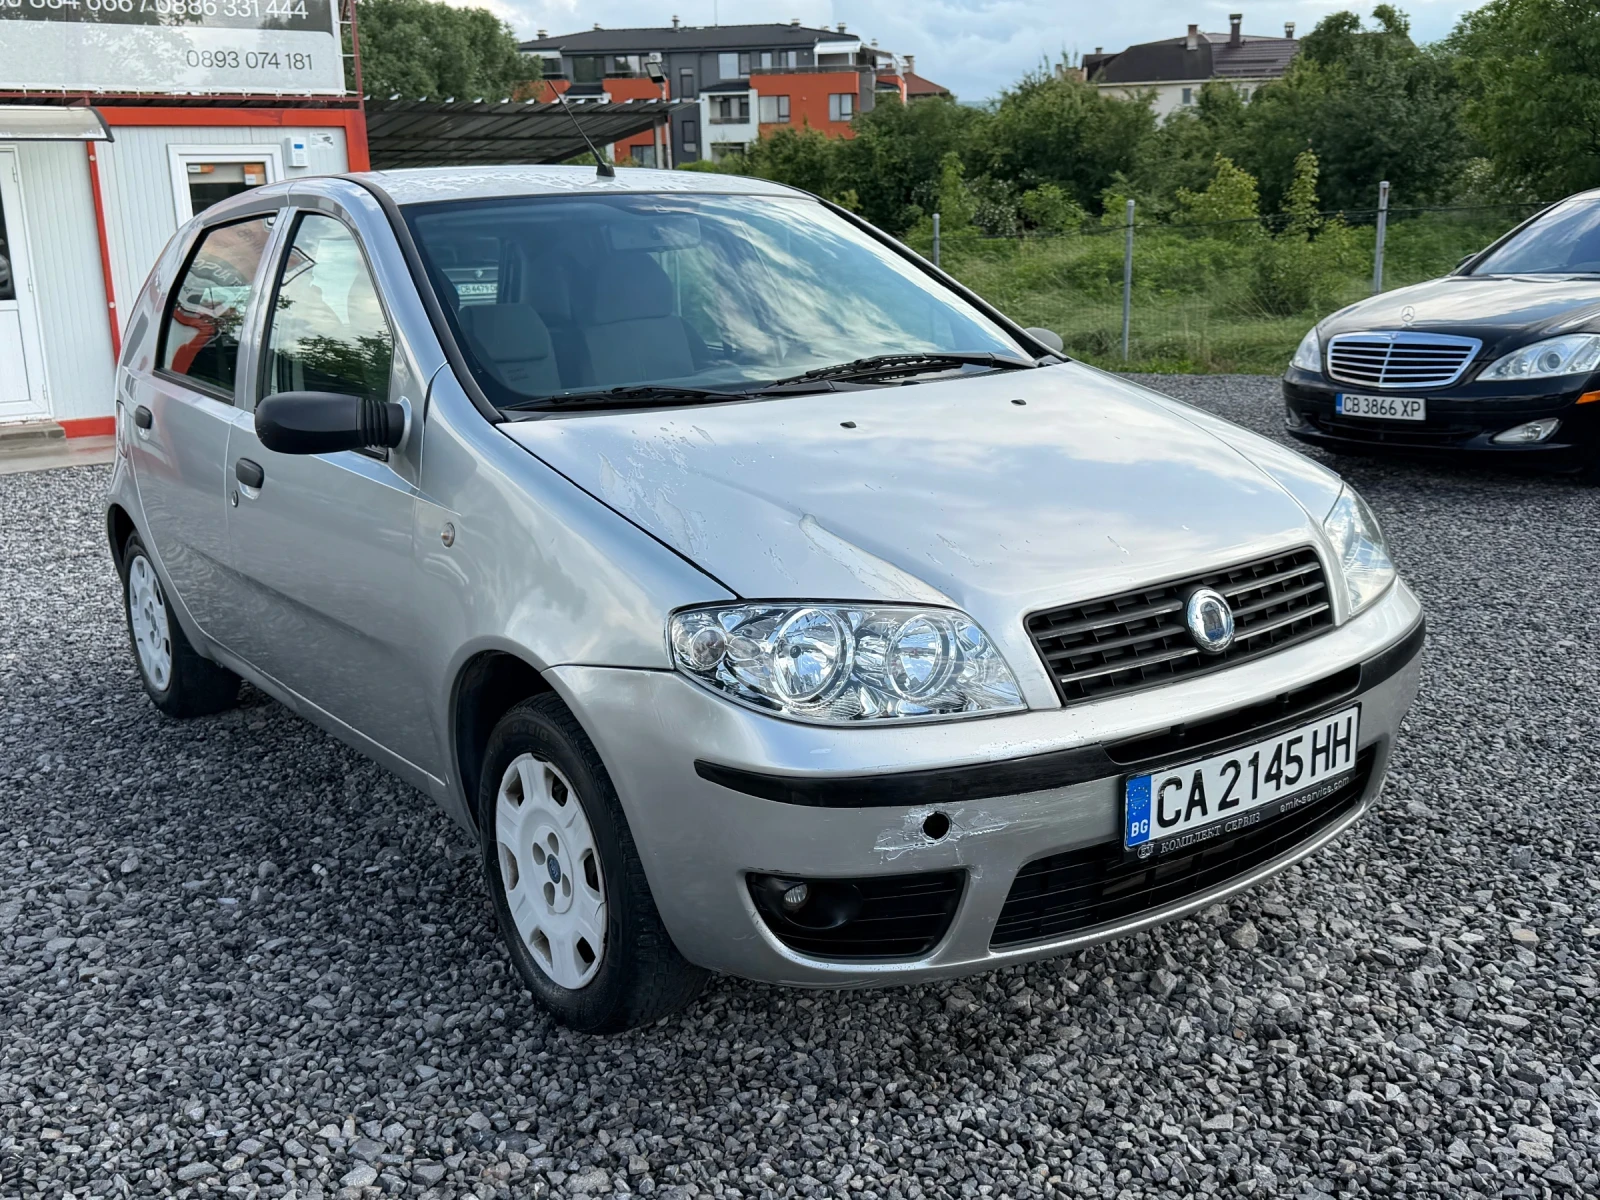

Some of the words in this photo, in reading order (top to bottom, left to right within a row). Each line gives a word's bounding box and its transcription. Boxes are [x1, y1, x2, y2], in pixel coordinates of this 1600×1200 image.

[155, 0, 217, 16] 0886
[223, 0, 259, 18] 331
[265, 0, 309, 20] 444
[186, 49, 240, 69] 0893
[245, 51, 281, 70] 074
[285, 53, 313, 70] 181
[1343, 396, 1360, 413] CB
[1362, 397, 1397, 416] 3866
[1400, 400, 1421, 417] XP
[1157, 768, 1208, 829] CA
[1218, 735, 1304, 812] 2145
[1310, 715, 1353, 778] HH
[1280, 776, 1350, 813] emk-service.com
[1131, 819, 1149, 838] BG
[1160, 825, 1222, 854] КОМПЛЕКТ
